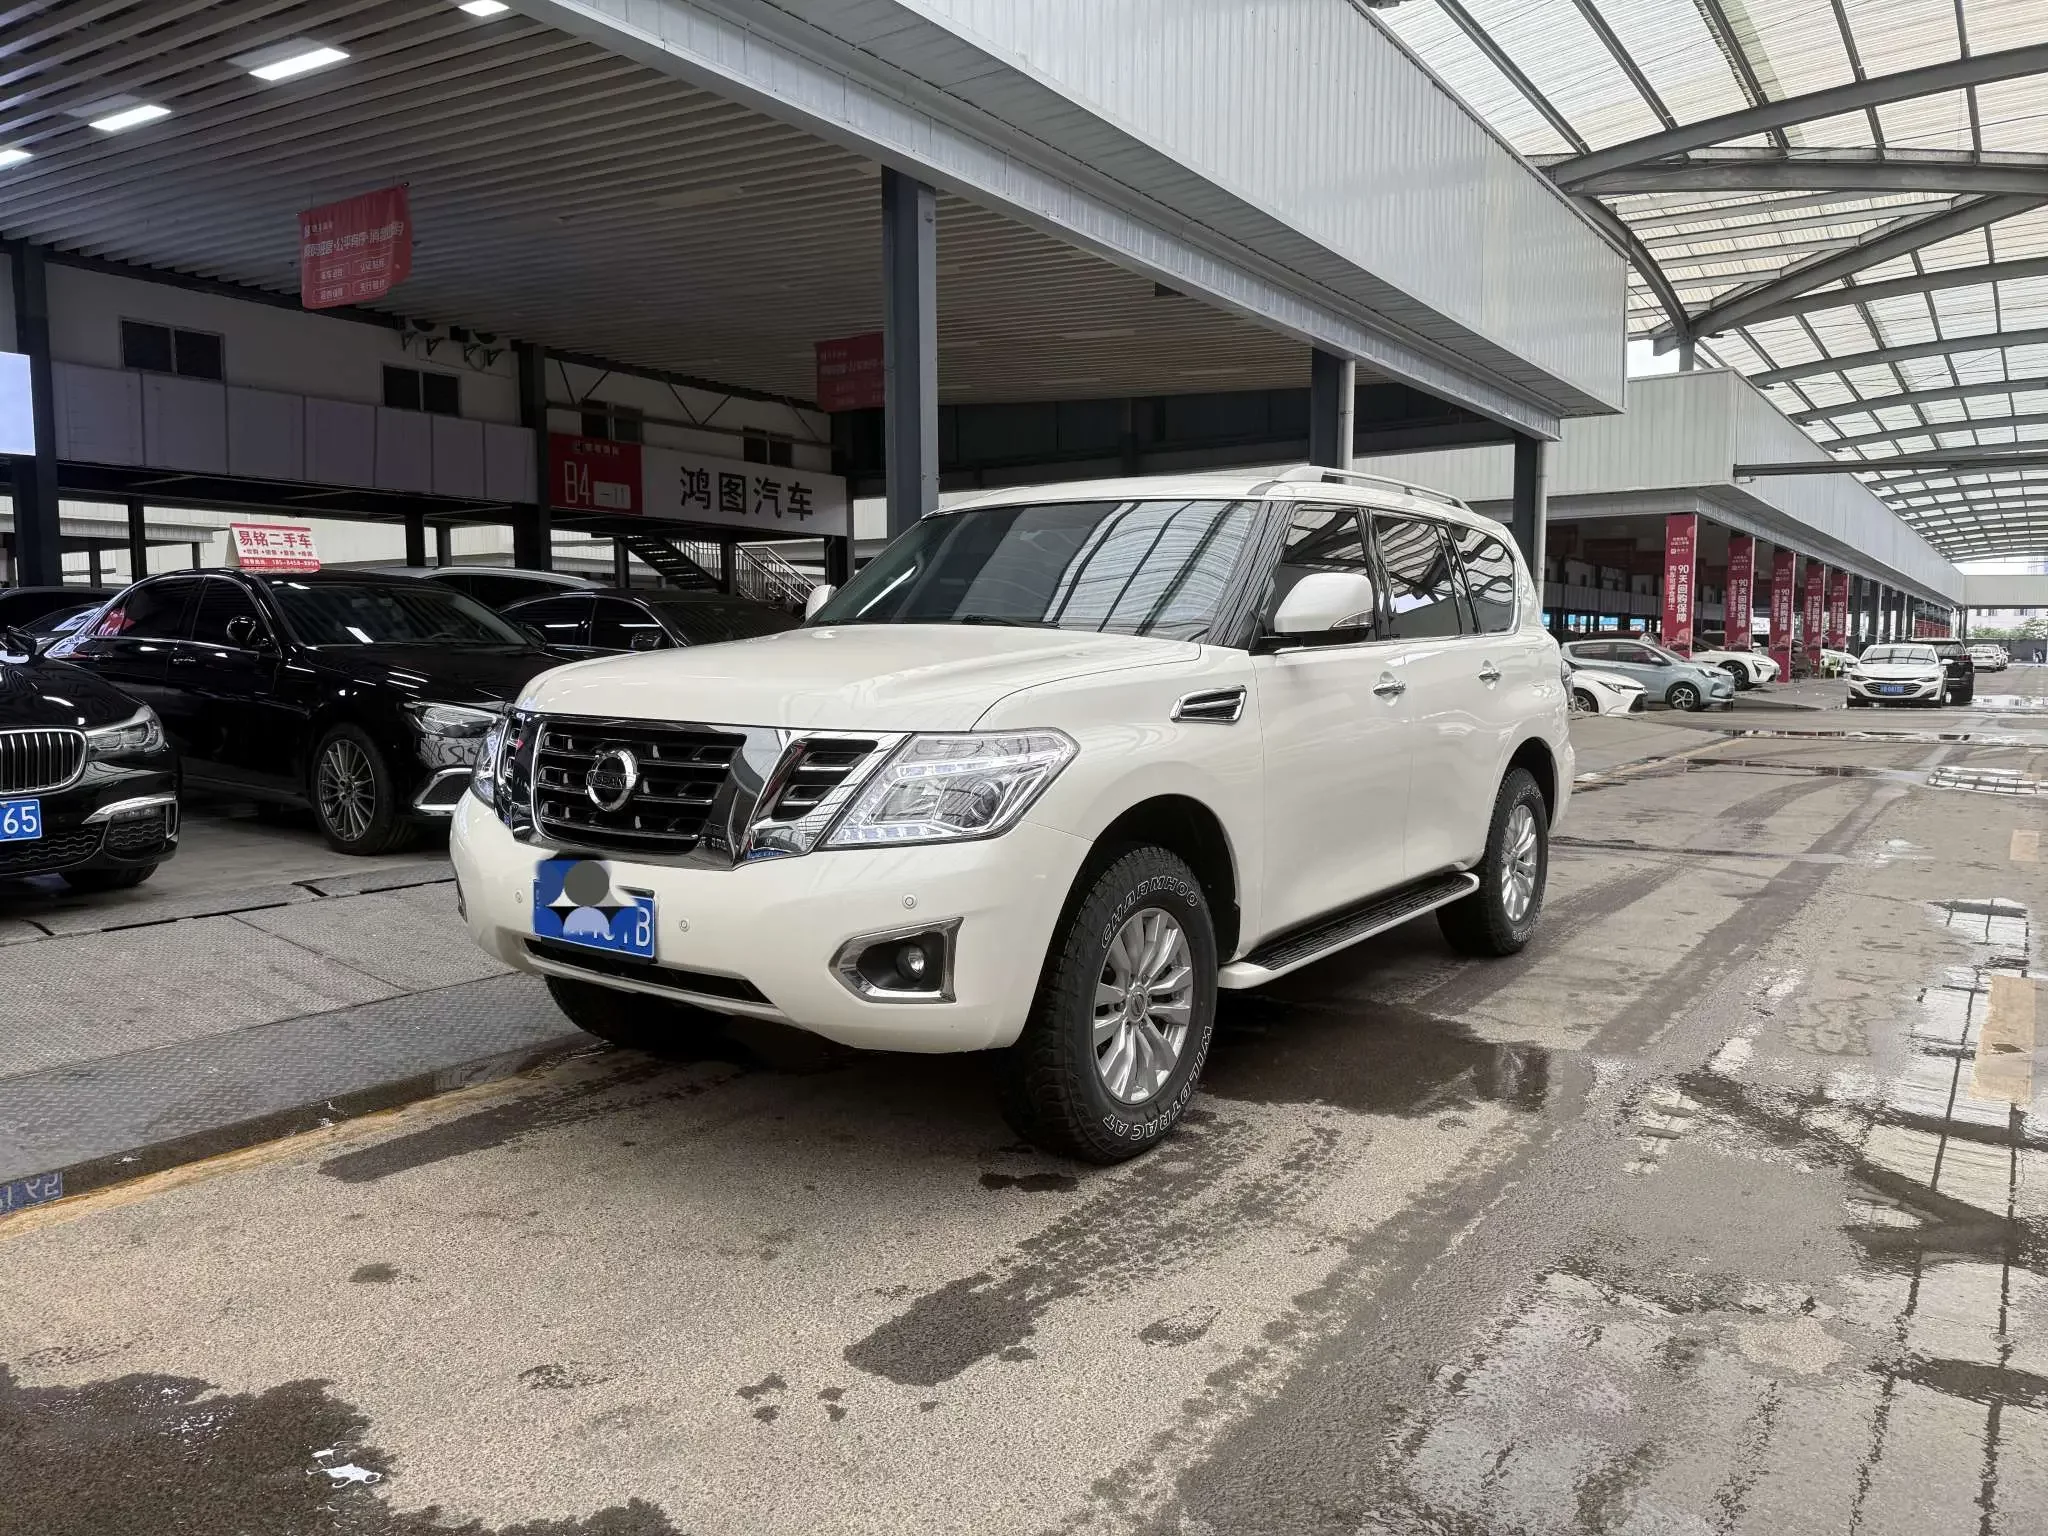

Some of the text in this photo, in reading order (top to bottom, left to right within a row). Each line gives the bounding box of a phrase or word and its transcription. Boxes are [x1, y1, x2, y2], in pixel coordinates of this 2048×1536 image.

[680, 466, 813, 521] 鸿图汽车
[238, 530, 312, 548] 易铭二手车
[1677, 564, 1690, 624] 90天回购保障
[3, 805, 38, 835] 65
[1101, 875, 1199, 950] CHARMHOO
